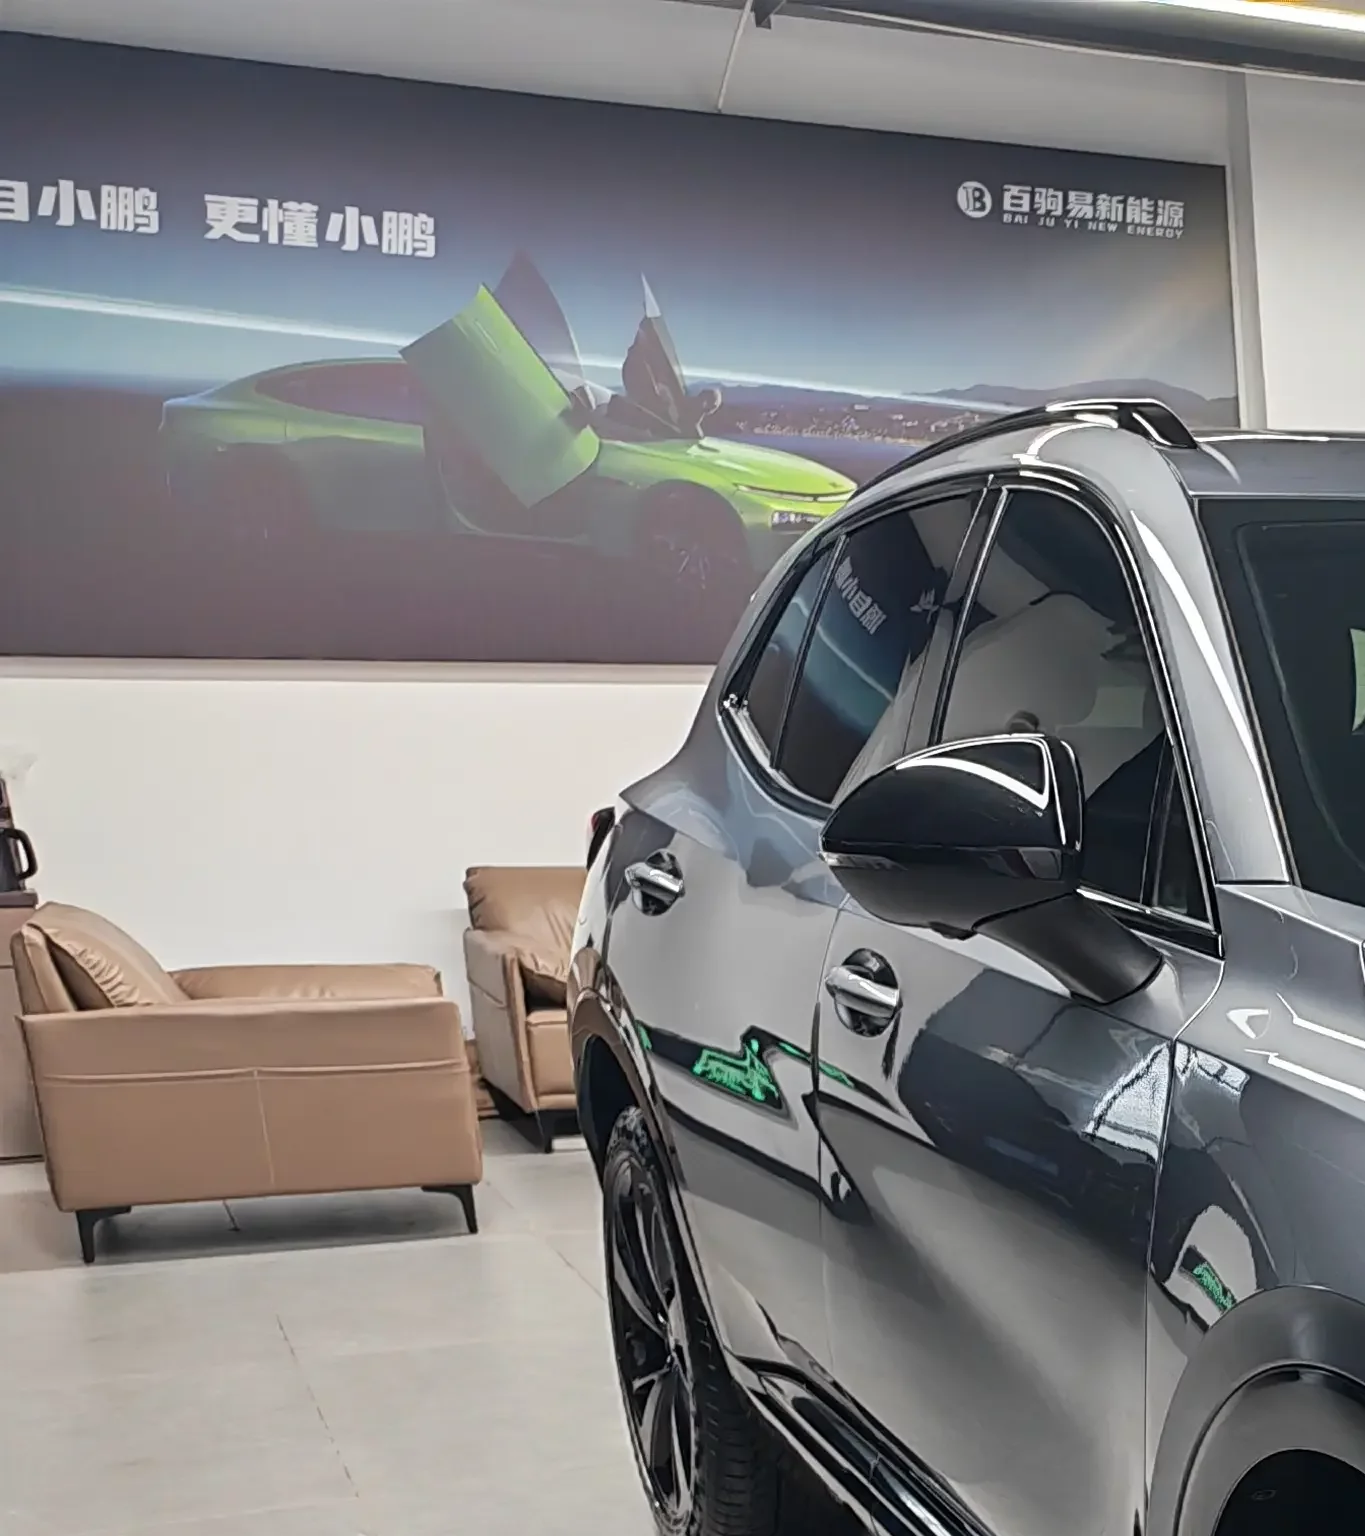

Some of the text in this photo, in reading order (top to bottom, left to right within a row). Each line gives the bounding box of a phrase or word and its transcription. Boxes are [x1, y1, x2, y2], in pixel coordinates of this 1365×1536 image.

[204, 193, 436, 258] 更懂小鹏
[1002, 184, 1185, 228] 百驹易新能源
[1003, 213, 1028, 224] BAI
[1038, 217, 1055, 227] JU
[1088, 221, 1118, 232] NEW
[1127, 226, 1184, 240] ENERGY
